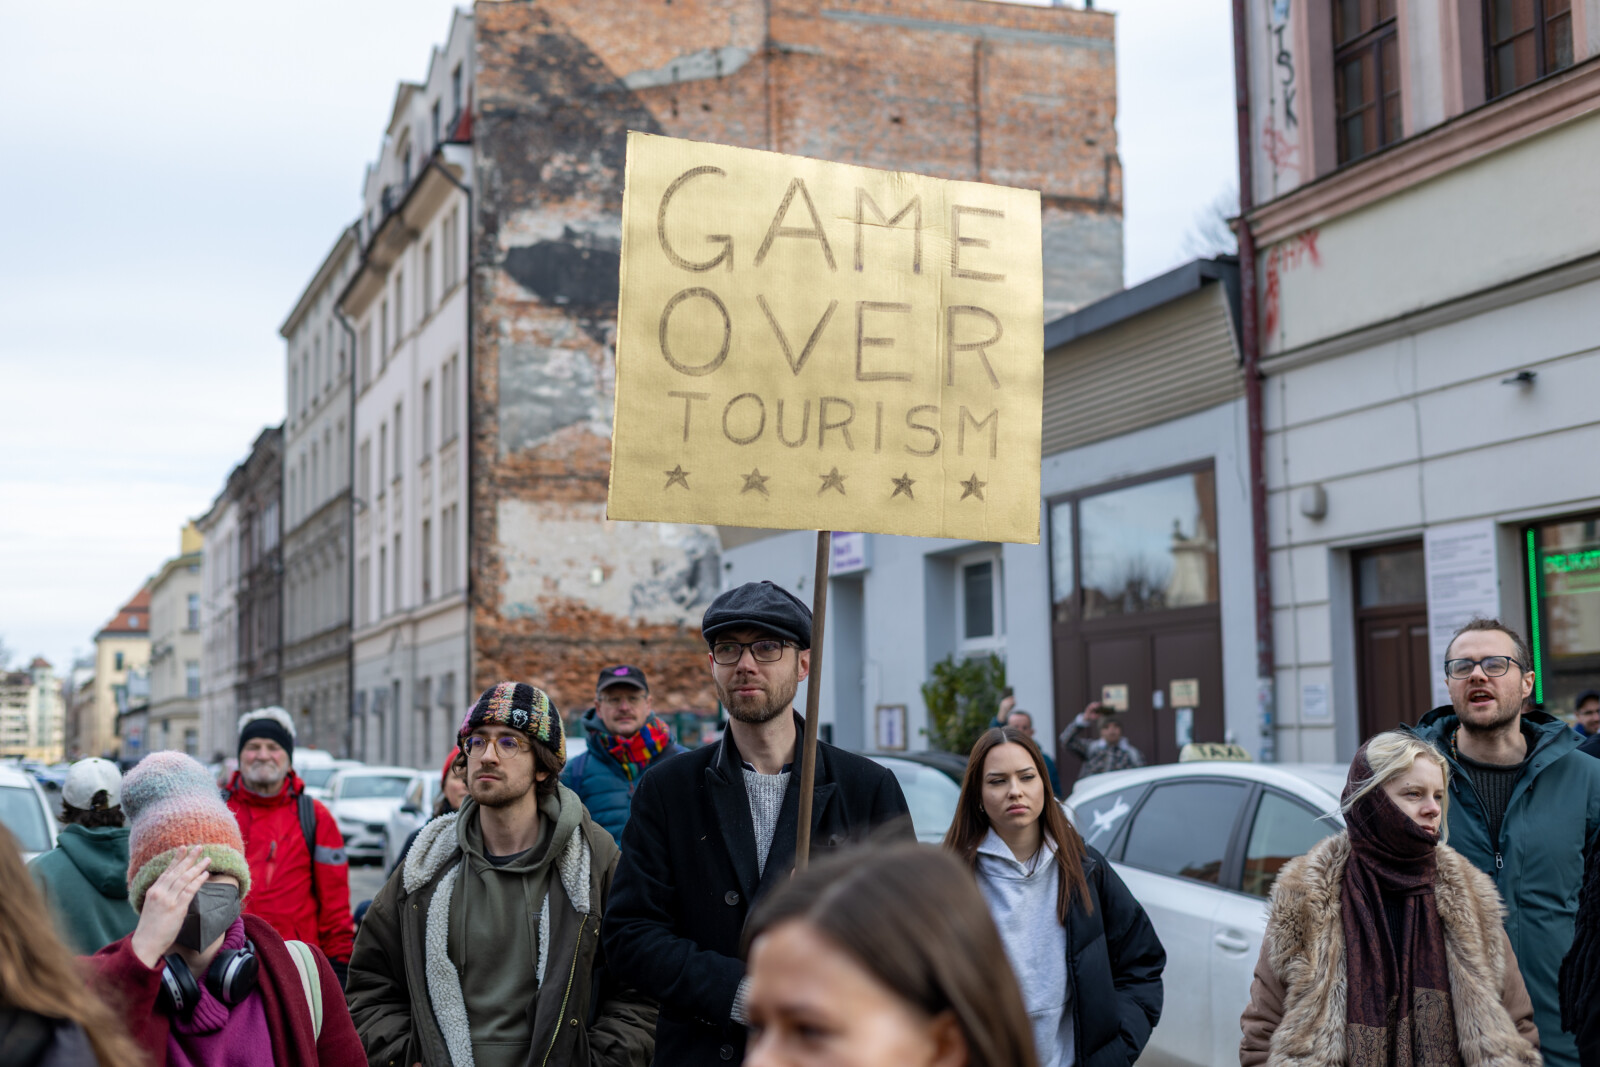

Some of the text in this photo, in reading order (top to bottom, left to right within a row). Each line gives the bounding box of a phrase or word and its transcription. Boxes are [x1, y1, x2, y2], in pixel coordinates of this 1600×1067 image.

[657, 165, 1006, 282] GAME
[658, 286, 1004, 390] OVER
[667, 390, 999, 460] TOURISM
